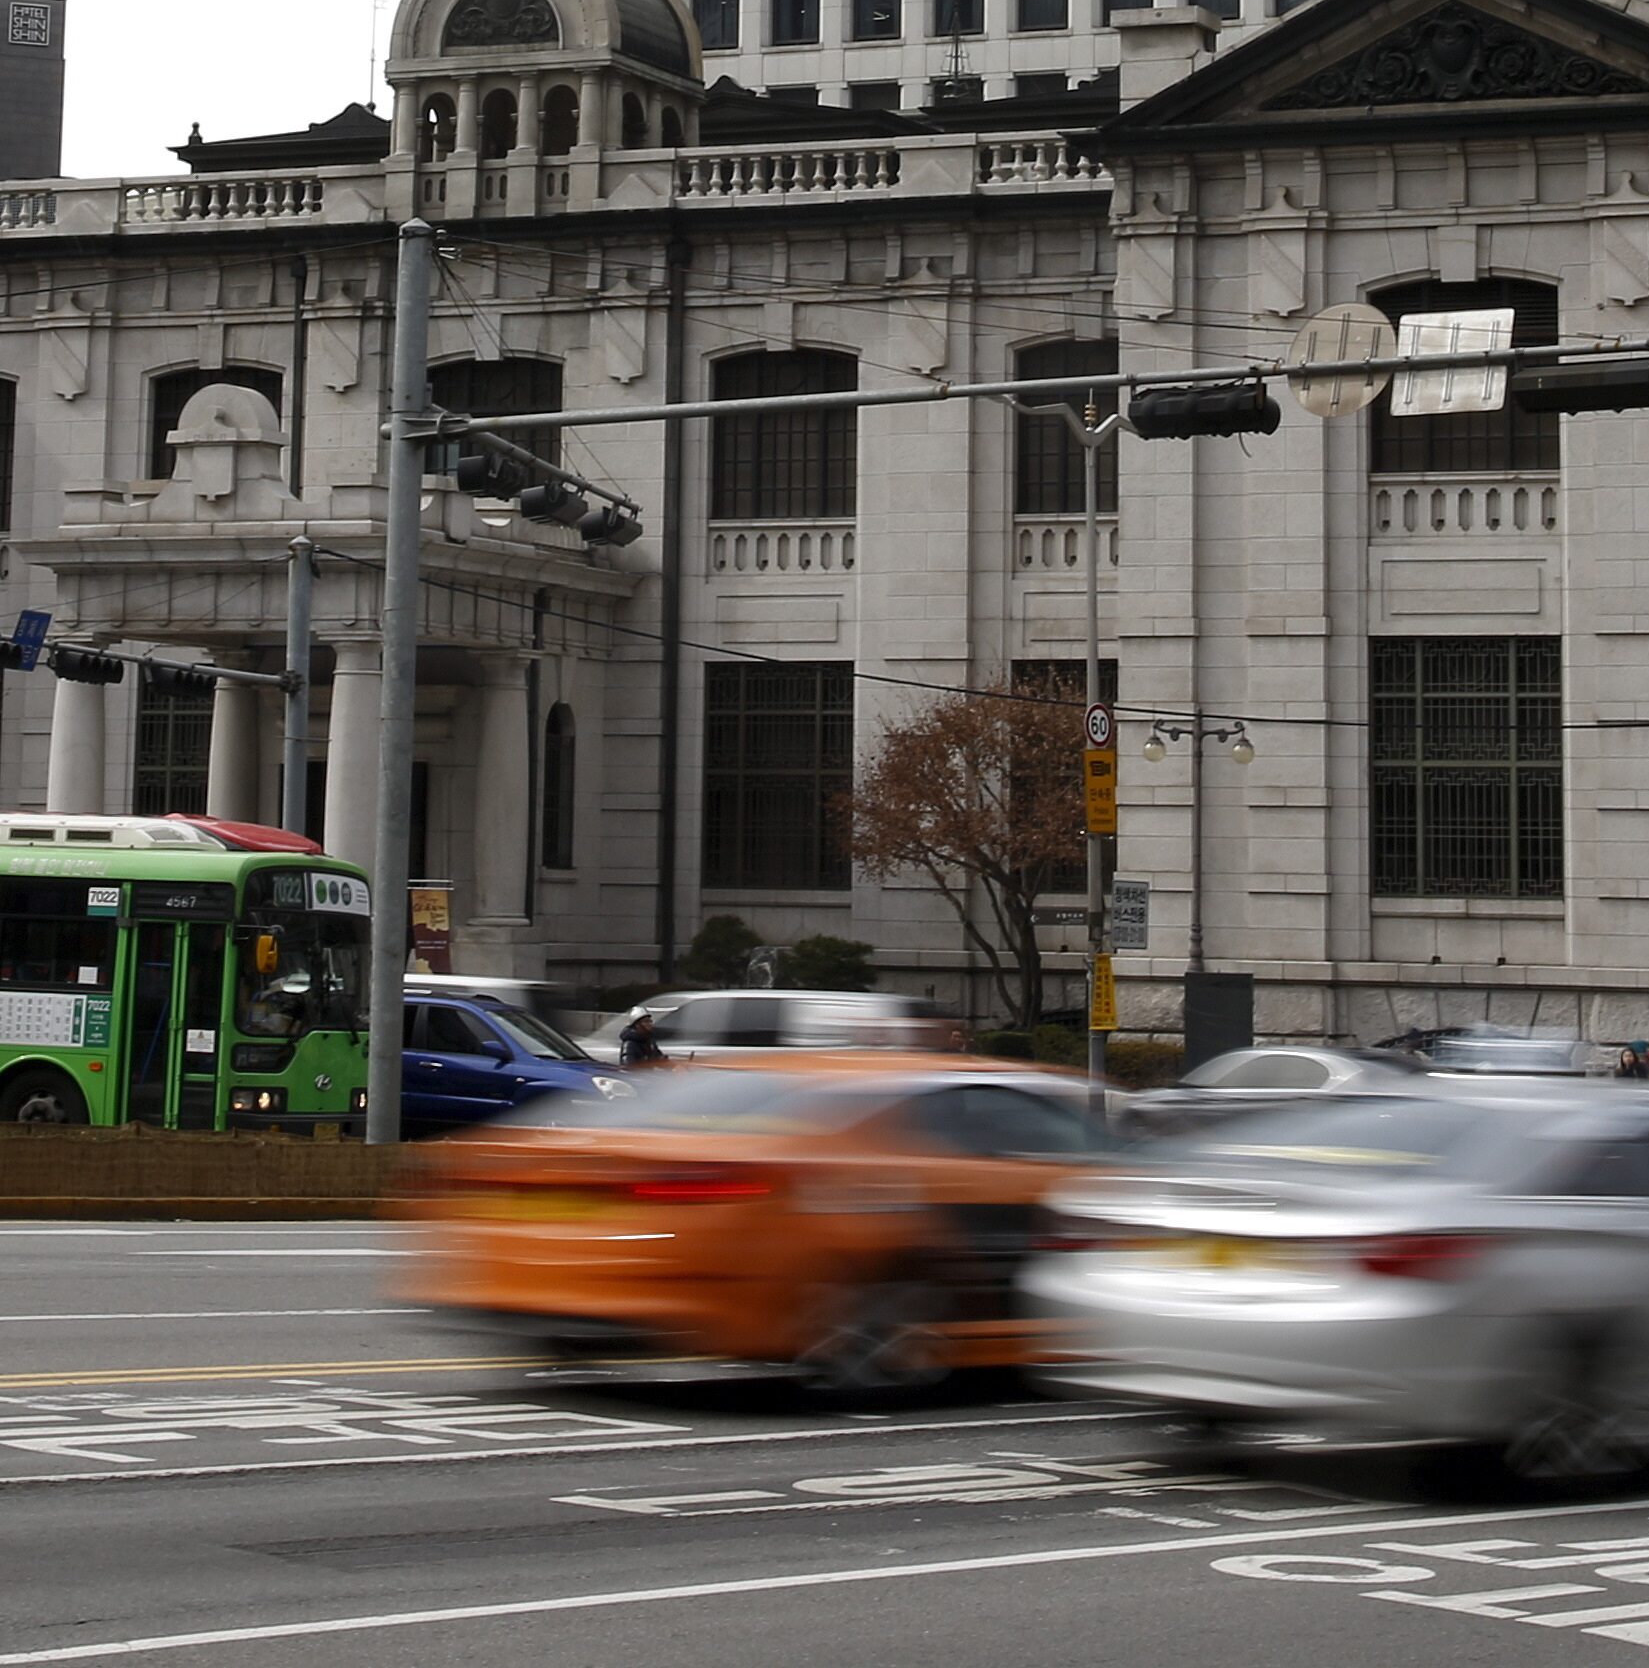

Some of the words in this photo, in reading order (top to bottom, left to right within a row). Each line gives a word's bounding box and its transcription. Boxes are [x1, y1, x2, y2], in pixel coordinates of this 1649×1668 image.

[13, 17, 46, 30] SHIN
[12, 29, 45, 42] SHIN
[1091, 715, 1107, 736] 60
[273, 875, 302, 903] 7022
[89, 889, 118, 904] 7022
[87, 999, 111, 1011] 7022
